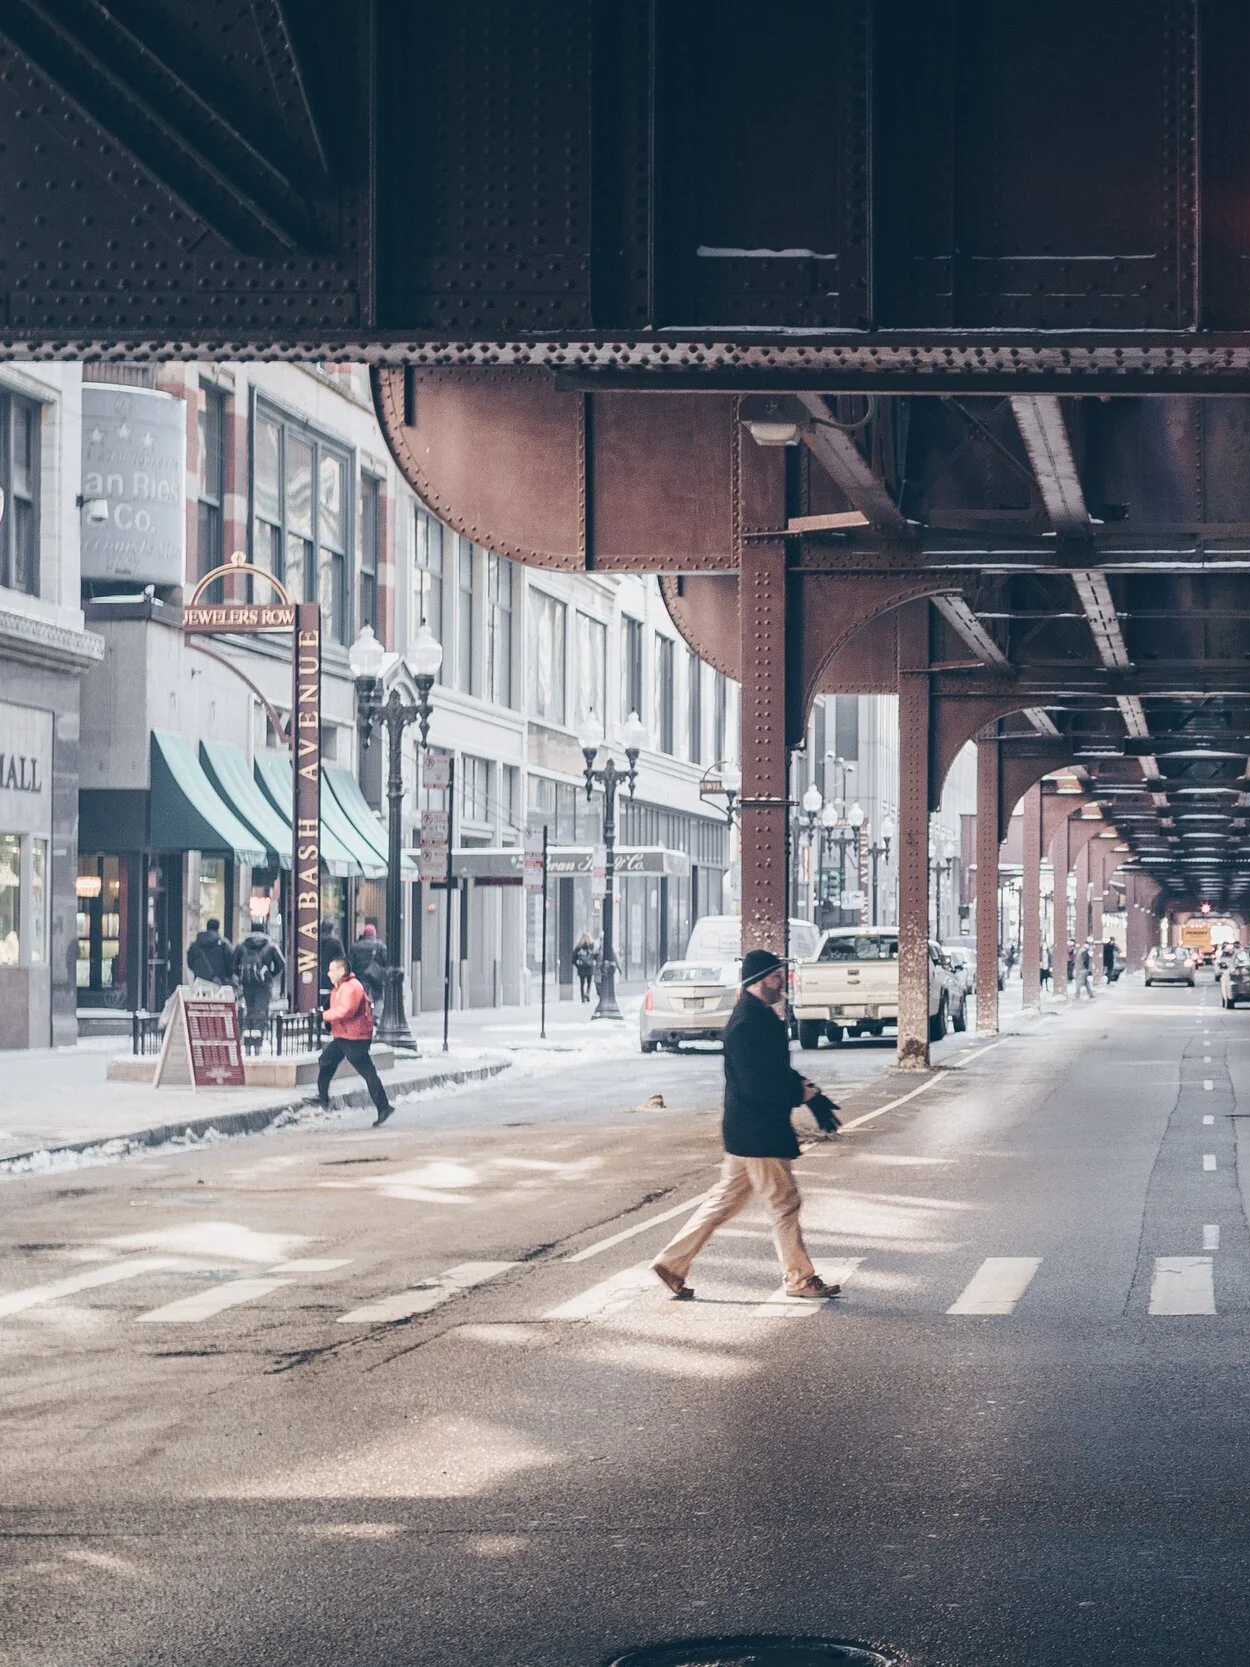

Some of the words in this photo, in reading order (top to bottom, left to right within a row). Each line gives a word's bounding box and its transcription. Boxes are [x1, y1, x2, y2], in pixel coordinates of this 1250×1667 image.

[113, 503, 156, 532] Co.
[183, 608, 258, 626] JEWELERS
[261, 608, 294, 625] ROW
[297, 629, 320, 782] AVENUE
[0, 752, 42, 793] ALL
[297, 817, 320, 974] WABASH
